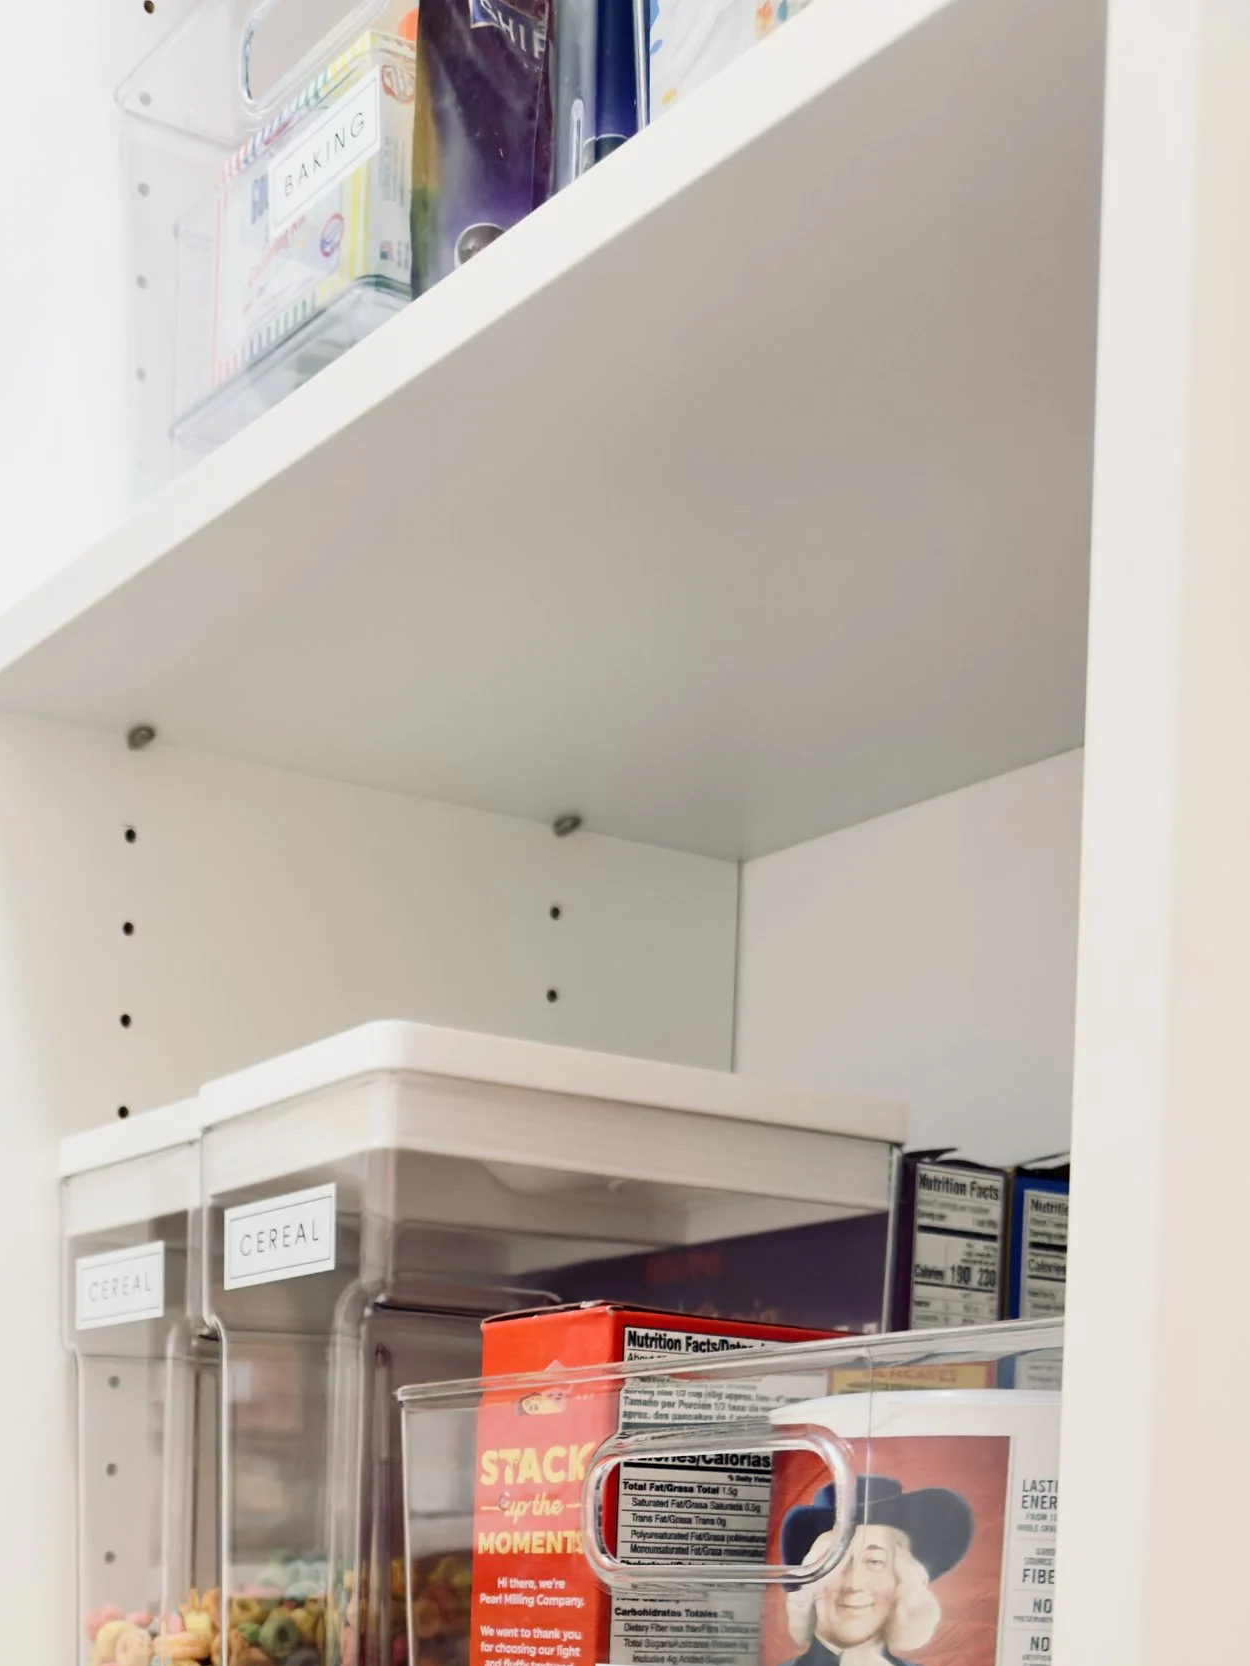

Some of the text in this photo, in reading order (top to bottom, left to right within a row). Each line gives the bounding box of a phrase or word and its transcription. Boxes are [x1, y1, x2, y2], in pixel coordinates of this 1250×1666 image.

[284, 112, 366, 199] BAKING
[919, 1174, 999, 1200] Nutrition Facts
[240, 1220, 319, 1256] CEREAL
[88, 1272, 152, 1302] CEREAL
[627, 1331, 681, 1351] Nutrition
[480, 1442, 596, 1485] STACK
[623, 1482, 738, 1496] Total Fat/Grasa Total 1.5g
[504, 1492, 563, 1525] up the
[632, 1498, 669, 1508] Saturated
[671, 1499, 708, 1510] Fat/Grasa
[632, 1513, 653, 1522] Trans
[655, 1514, 692, 1524] Fat/Grasa
[695, 1516, 715, 1525] Trans
[478, 1530, 585, 1554] MOMENTS
[497, 1578, 565, 1590] Hi there, we're
[479, 1593, 584, 1608] Pearl Milling Company.
[1033, 1599, 1052, 1613] NO
[614, 1607, 682, 1618] Carbohidratos
[480, 1625, 582, 1641] We want to thank you
[480, 1642, 581, 1659] for choosing our light
[1030, 1636, 1050, 1651] NO
